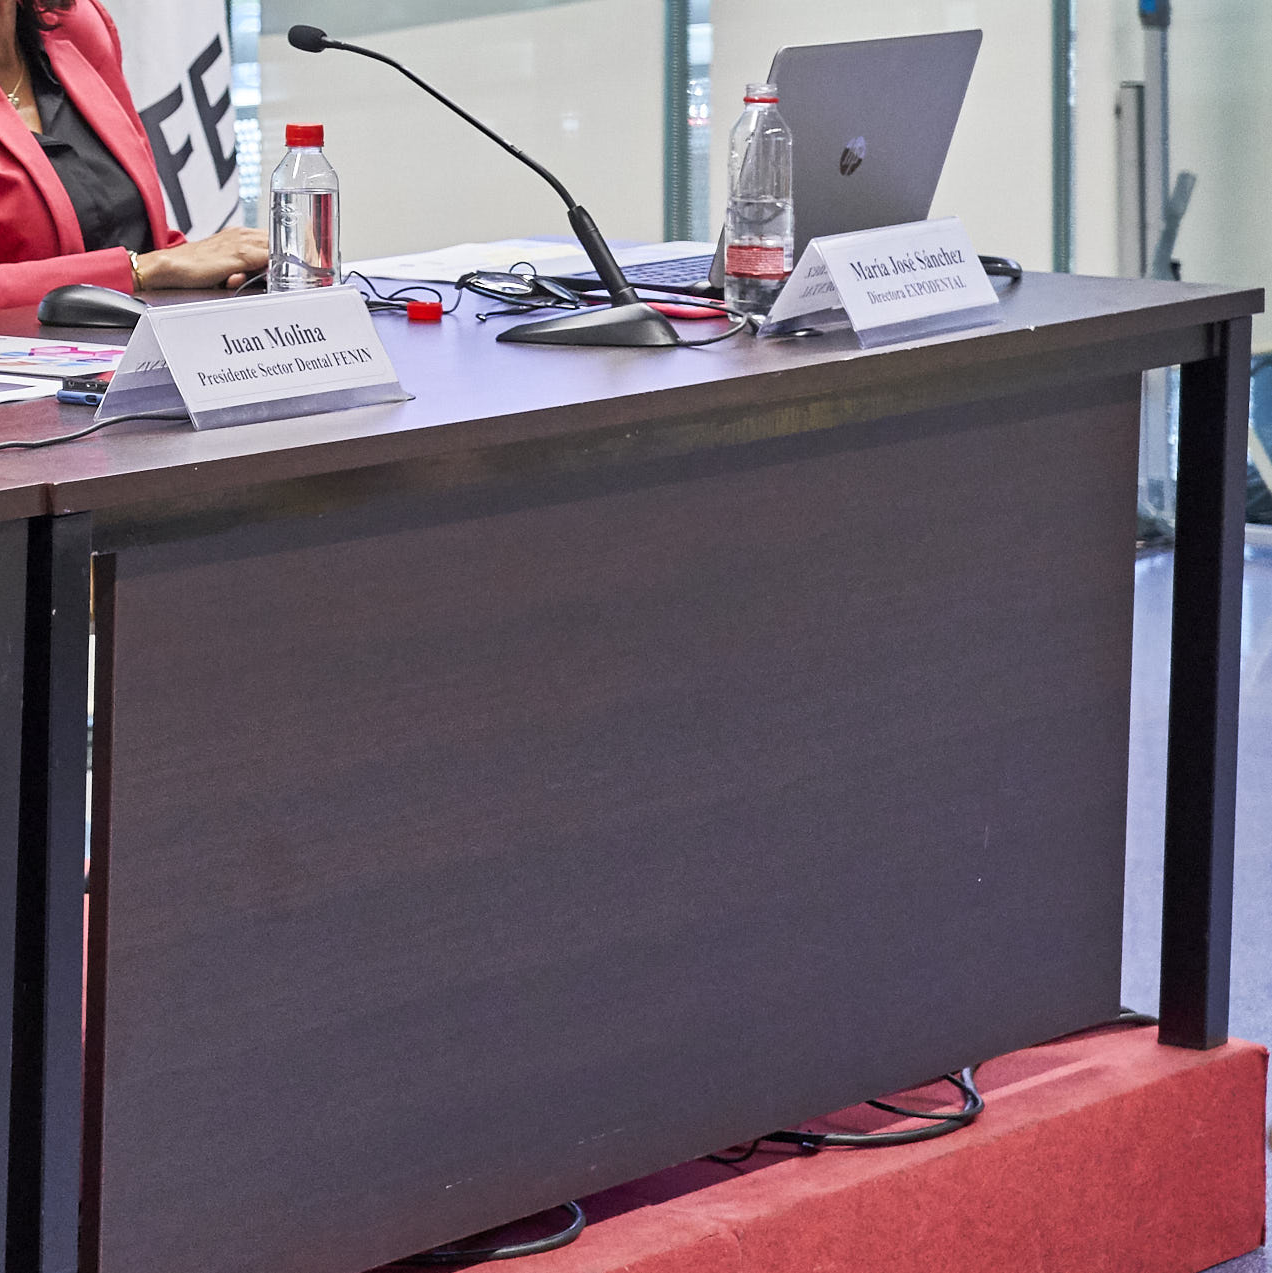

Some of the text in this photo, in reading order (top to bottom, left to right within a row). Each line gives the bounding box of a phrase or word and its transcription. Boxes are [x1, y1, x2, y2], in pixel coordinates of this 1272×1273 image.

[139, 33, 238, 235] FE
[850, 257, 889, 282] María
[888, 253, 914, 275] José
[913, 246, 965, 272] Sánchez
[867, 276, 967, 305] Directora EXPODENTAL
[221, 324, 327, 356] Juan Molina
[197, 347, 373, 387] Presidente Sector Dental FENIN
